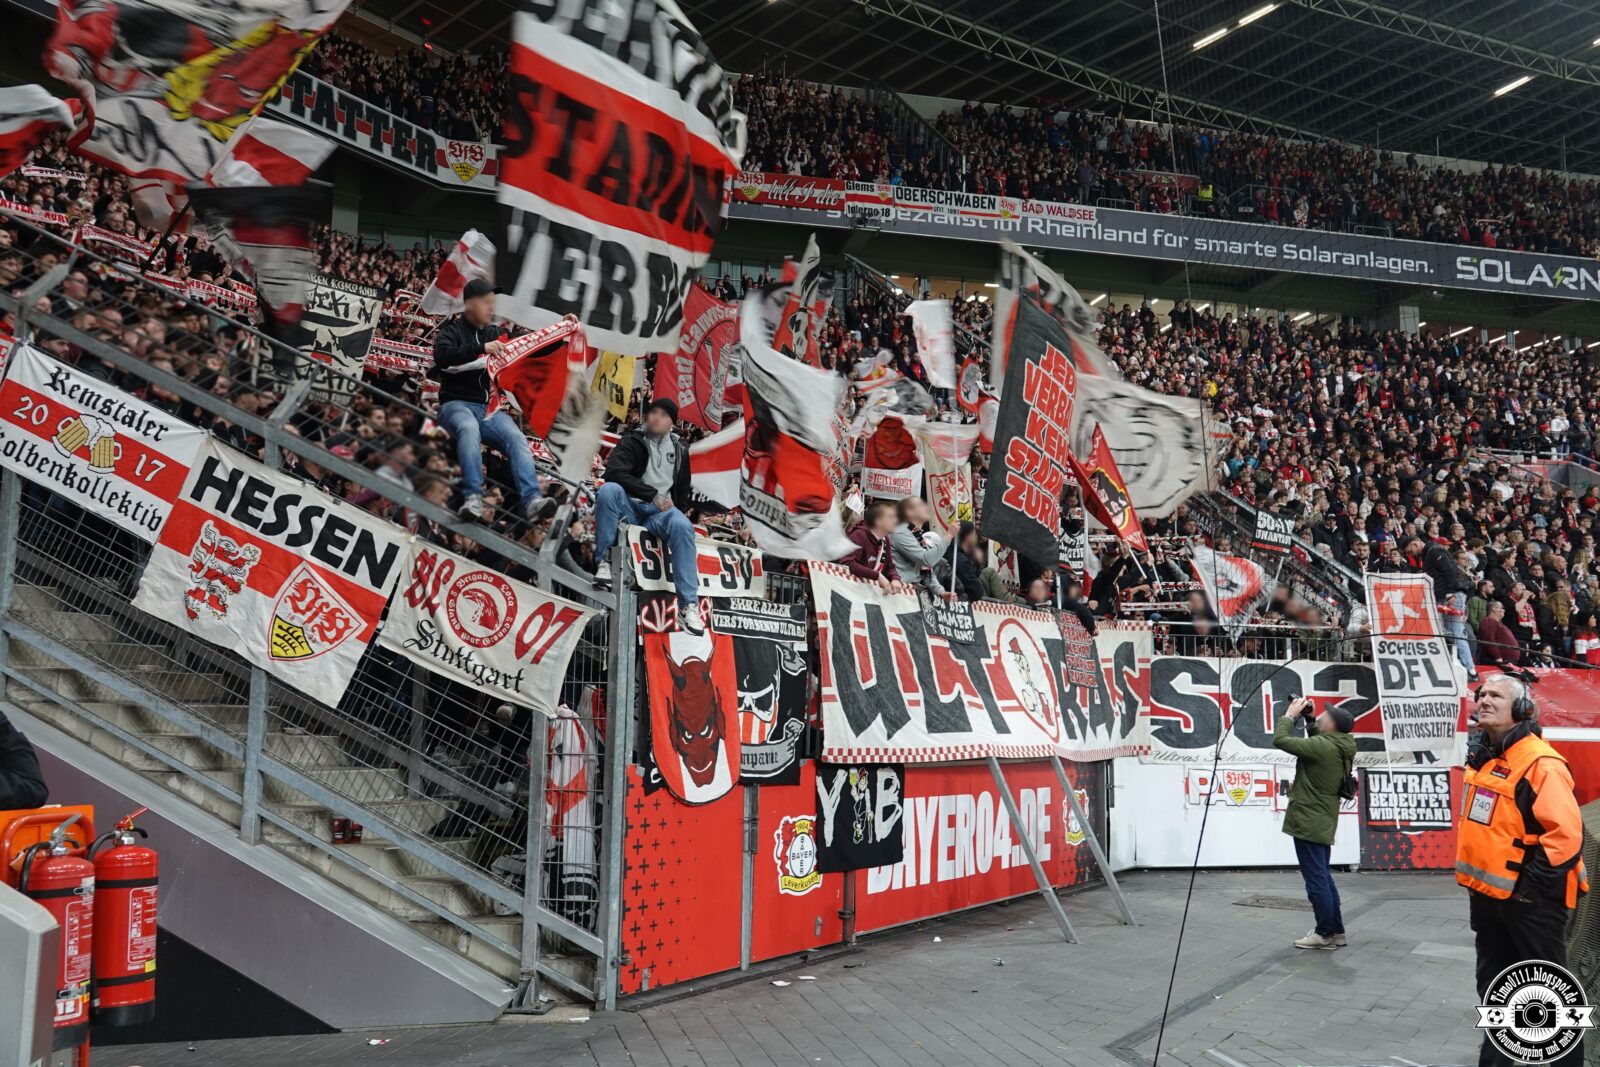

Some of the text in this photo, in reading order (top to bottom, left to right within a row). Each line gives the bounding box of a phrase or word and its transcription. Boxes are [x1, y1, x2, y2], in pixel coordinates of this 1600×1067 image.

[845, 181, 875, 193] Glems
[895, 187, 996, 210] OBERSCHWABEN
[880, 206, 891, 217] 18
[1021, 202, 1096, 221] BAD WALDSEE
[1027, 216, 1147, 245] Rheinland
[1153, 228, 1189, 249] für
[1194, 238, 1277, 258] smarte
[1282, 243, 1435, 274] Solaranlagen.
[43, 365, 169, 443] Remstaler
[12, 395, 167, 482] 20 17
[190, 455, 401, 590] HESSEN
[716, 546, 753, 590] SV
[760, 602, 792, 618] ALLEN
[514, 601, 585, 665] 07
[402, 619, 525, 693] Stuttgart
[1377, 640, 1441, 656] SCHEISS
[1379, 657, 1453, 691] DFL
[1382, 701, 1402, 721] FÜR
[1203, 750, 1298, 763] Schwabenst
[1367, 773, 1449, 793] ULTRAS
[1369, 792, 1450, 808] BEDEUTET
[1473, 798, 1491, 812] 740
[1368, 807, 1452, 821] WIDERSTAND
